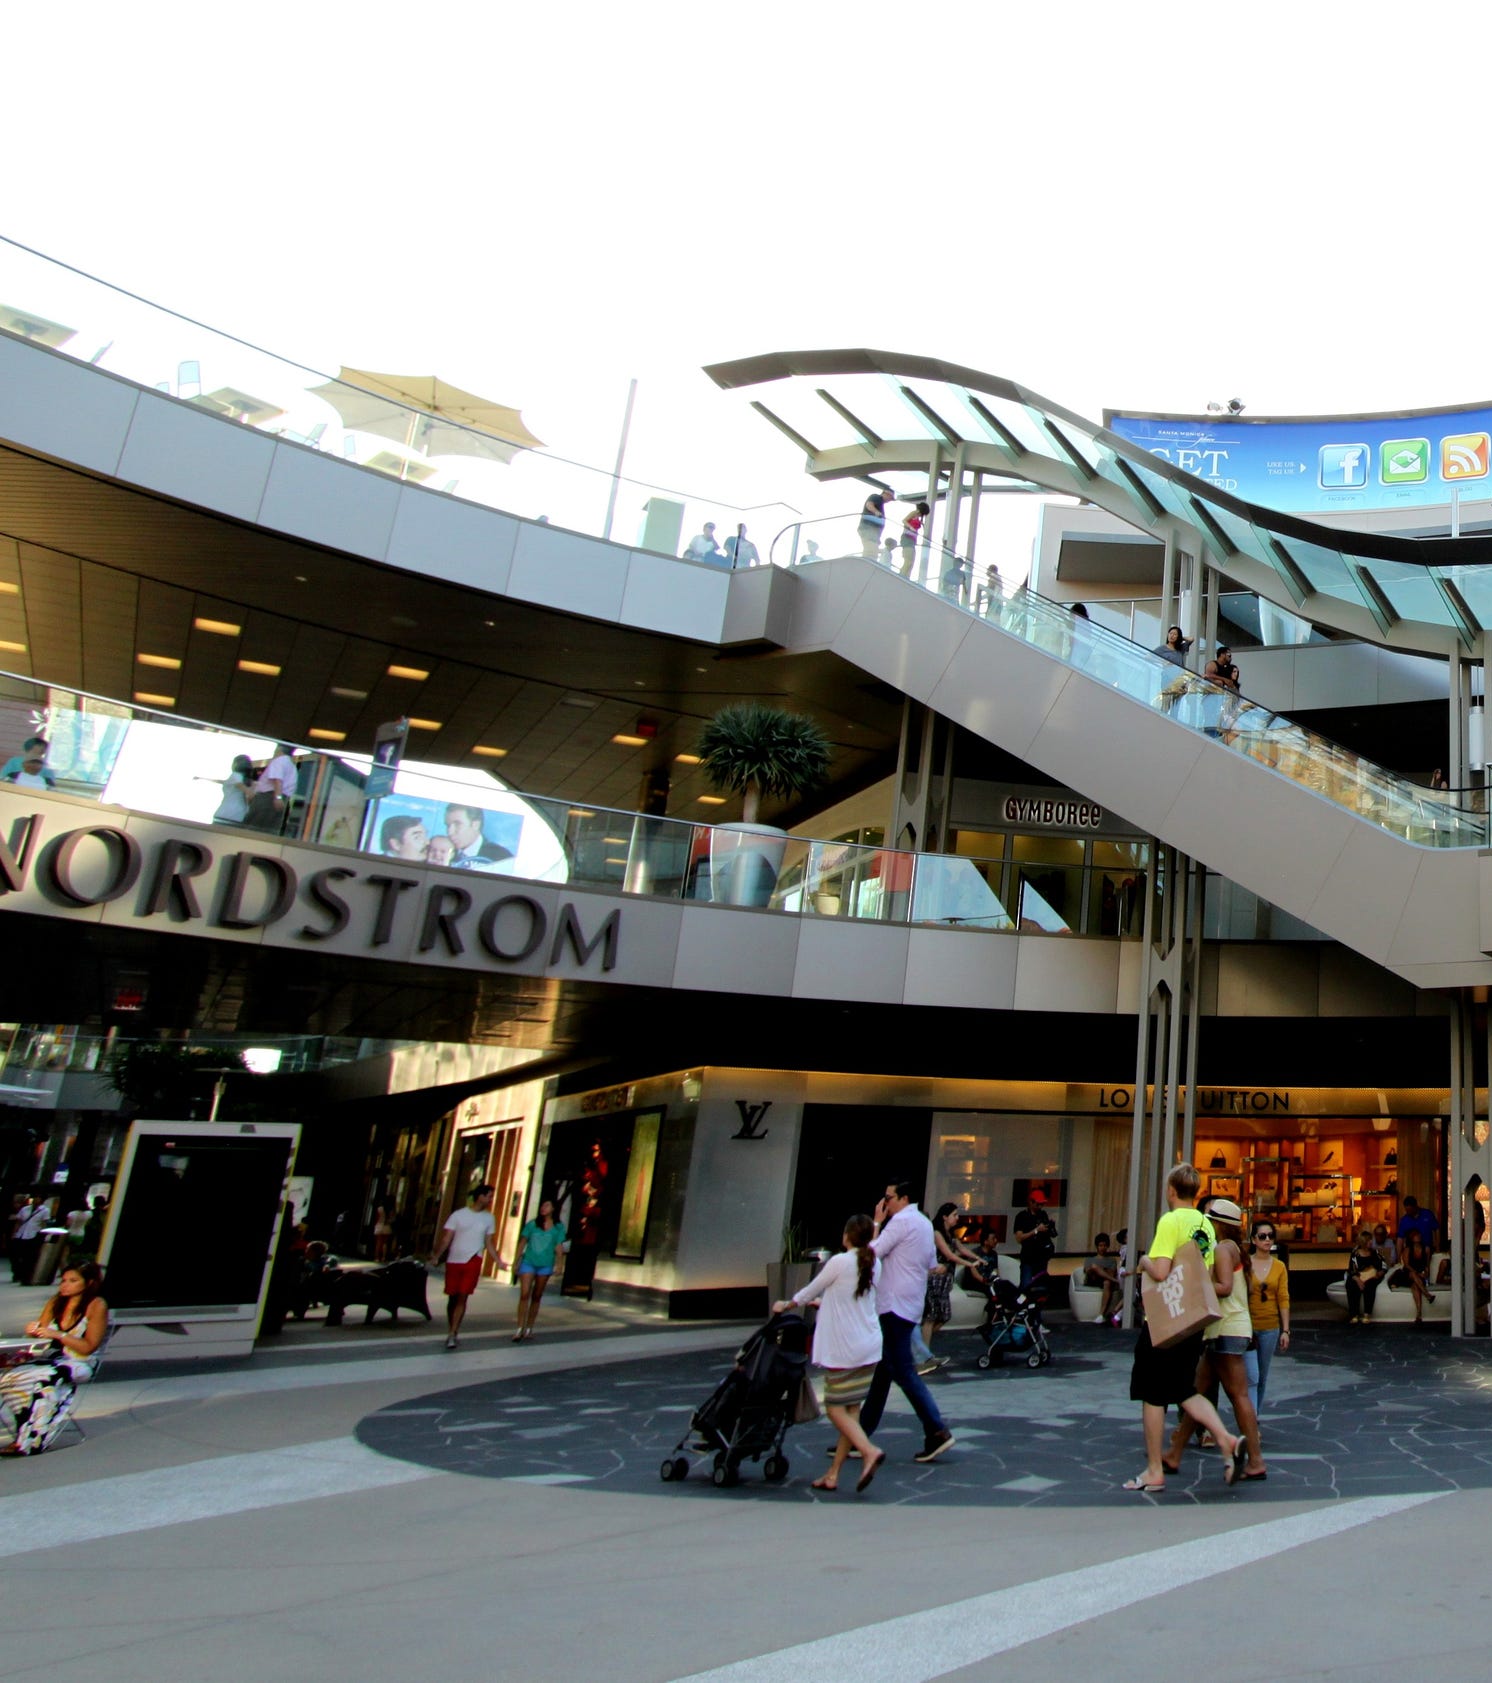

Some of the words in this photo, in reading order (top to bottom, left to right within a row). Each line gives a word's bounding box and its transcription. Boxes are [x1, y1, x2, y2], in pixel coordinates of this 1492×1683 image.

[1183, 1091, 1289, 1112] UITTON
[1157, 1264, 1184, 1293] JUST
[1162, 1283, 1184, 1305] DO
